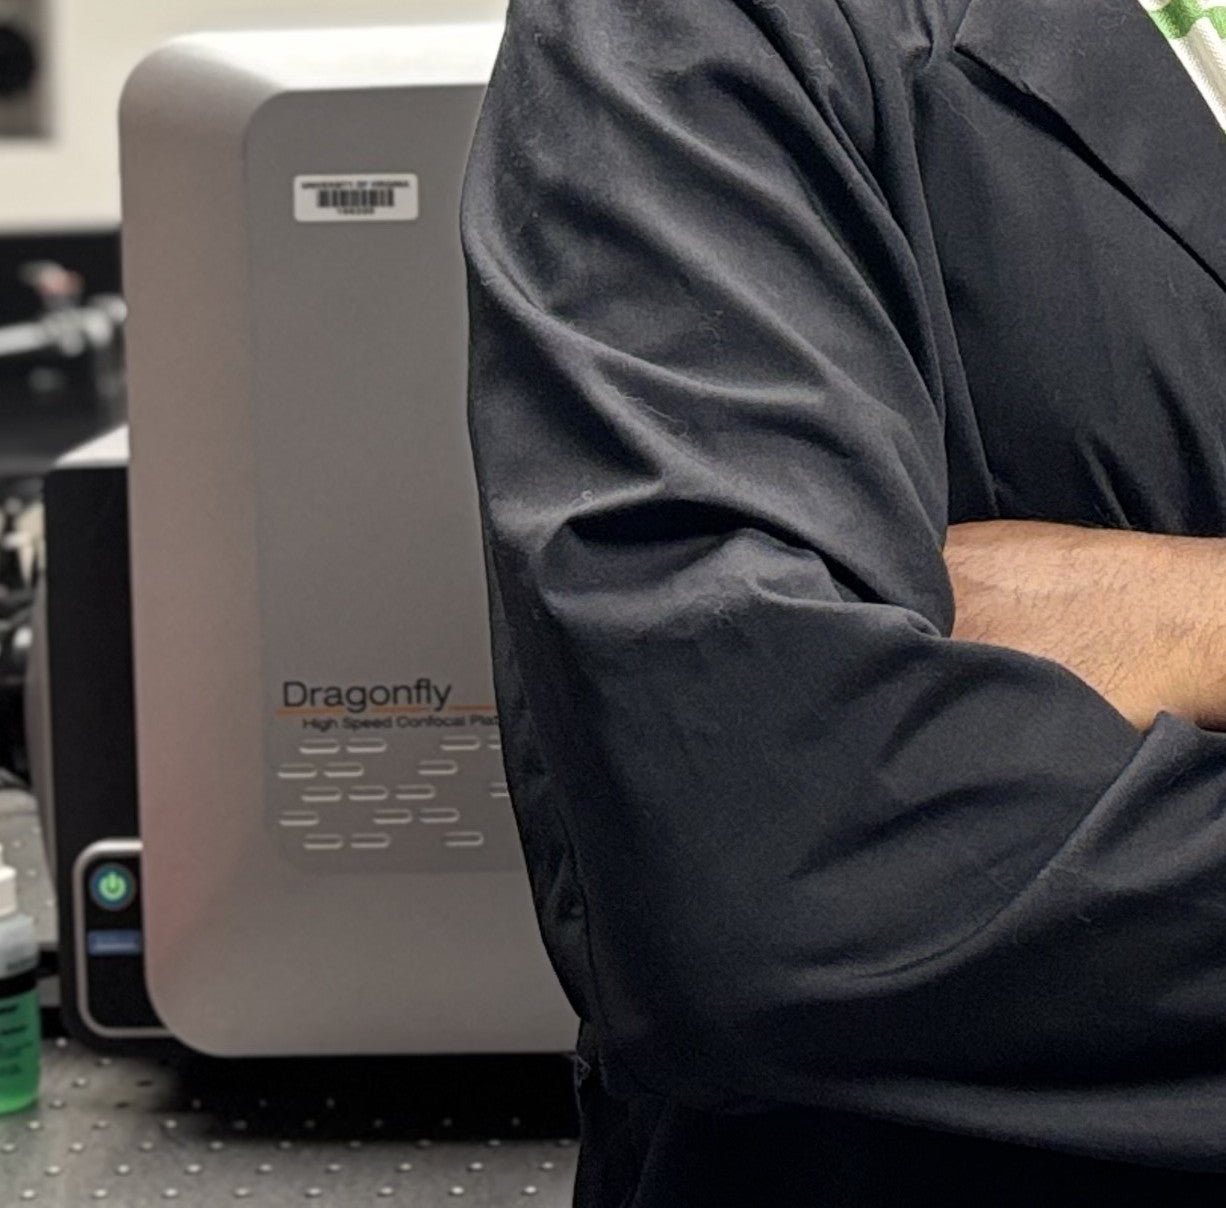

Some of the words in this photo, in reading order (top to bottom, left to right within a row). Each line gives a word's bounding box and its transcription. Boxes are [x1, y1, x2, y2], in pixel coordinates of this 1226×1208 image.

[282, 678, 452, 714] Dragonfly
[302, 718, 338, 732] High
[343, 717, 393, 731] Speed
[396, 715, 467, 729] Confocal
